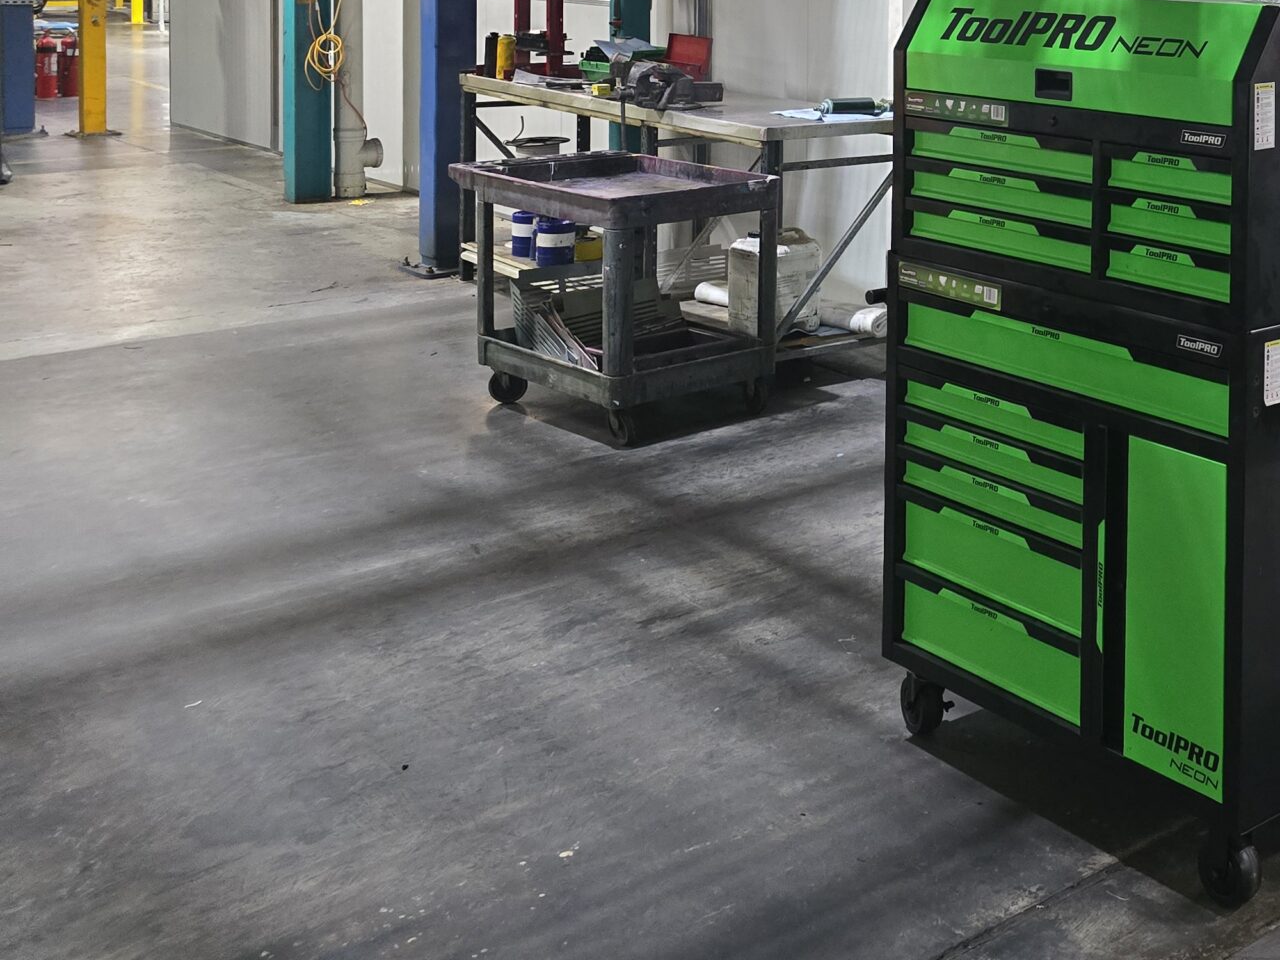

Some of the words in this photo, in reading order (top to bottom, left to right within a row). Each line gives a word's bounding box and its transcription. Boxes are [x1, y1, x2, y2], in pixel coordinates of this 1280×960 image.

[940, 7, 1117, 51] ToolPRO
[1110, 35, 1209, 59] NEON
[1183, 132, 1222, 146] ToolPRO
[1147, 155, 1180, 167] ToolPRO
[1146, 201, 1180, 215] ToolPRO
[1145, 248, 1178, 262] ToolPRO
[1031, 326, 1061, 341] ToolPRO
[1179, 337, 1218, 355] ToolPRO
[1131, 712, 1220, 773] ToolPRO
[1169, 758, 1219, 790] NEON
